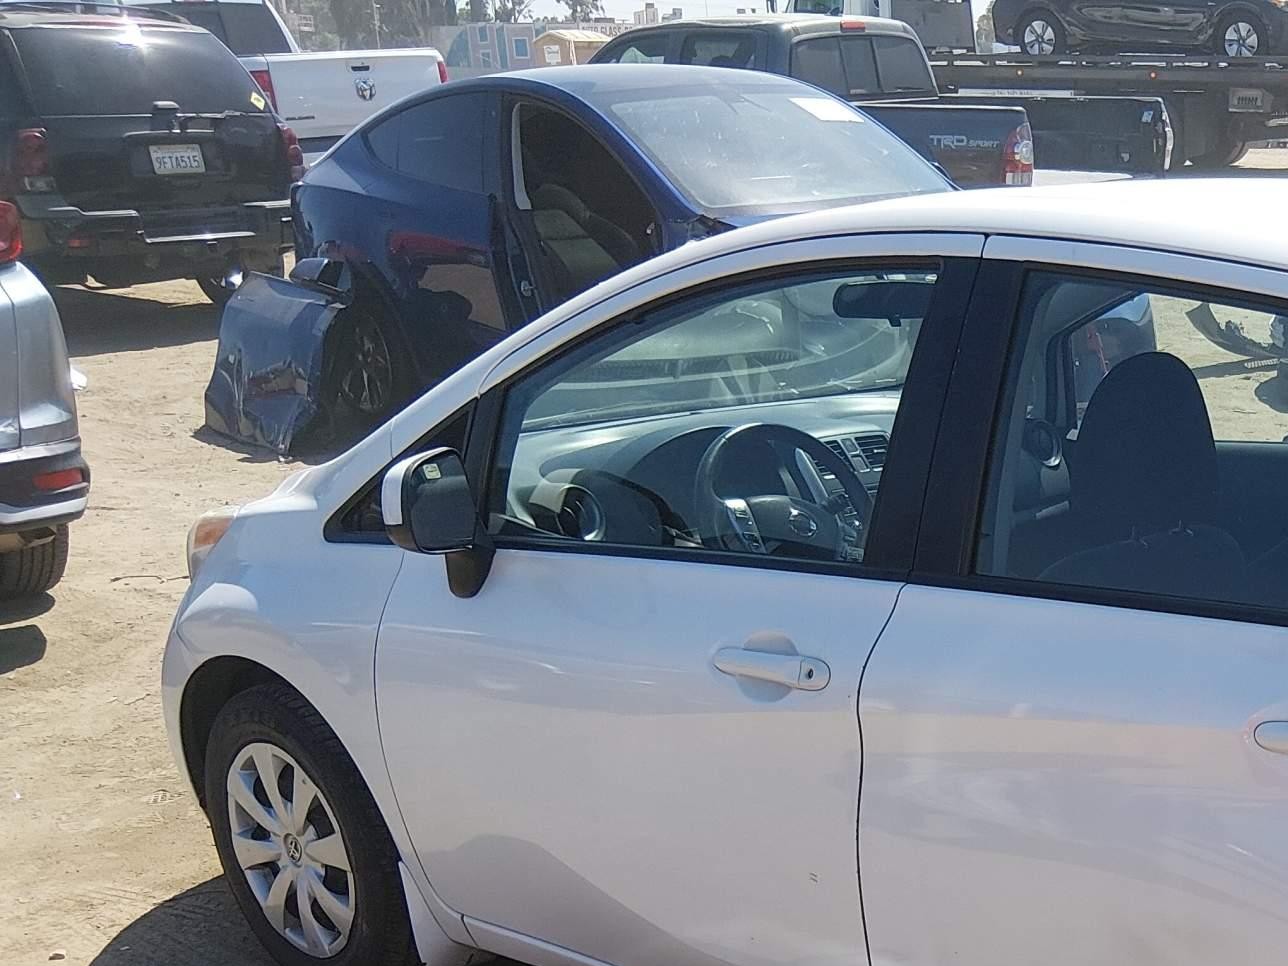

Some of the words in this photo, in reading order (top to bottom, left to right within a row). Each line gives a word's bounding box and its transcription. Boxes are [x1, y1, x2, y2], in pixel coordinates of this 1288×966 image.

[929, 135, 967, 149] TRD
[967, 140, 1000, 148] SPORT
[155, 155, 201, 169] 9FTA515
